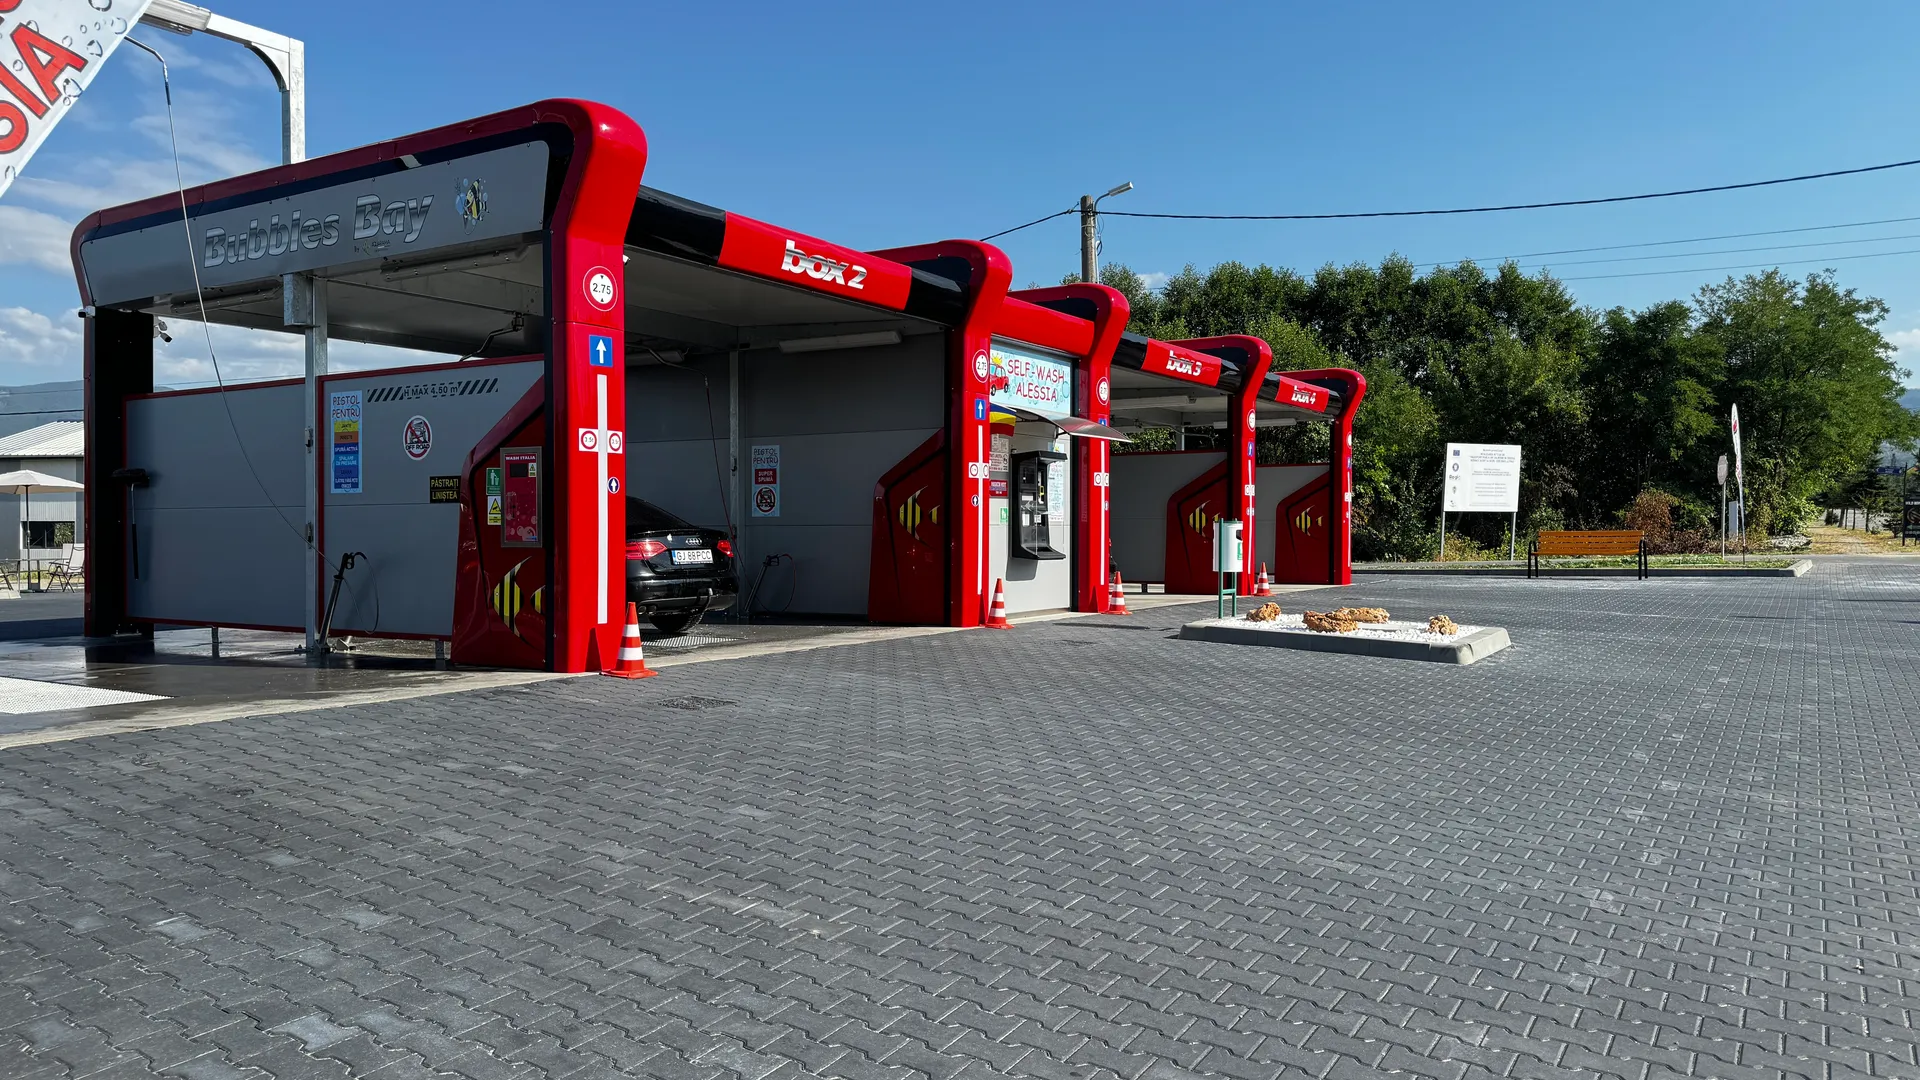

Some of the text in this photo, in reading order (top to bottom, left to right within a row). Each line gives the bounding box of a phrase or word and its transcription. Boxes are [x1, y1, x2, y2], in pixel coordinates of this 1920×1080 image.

[204, 194, 434, 268] Bubbles Bay
[781, 239, 867, 290] box 2
[592, 282, 612, 295] 2.75
[1166, 350, 1202, 376] box 3
[333, 395, 360, 405] PISTOL
[403, 389, 409, 397] H
[411, 387, 429, 396] MAX
[430, 386, 448, 395] 4.50
[1015, 382, 1058, 402] ALESSIA
[1292, 385, 1316, 404] box 4
[332, 408, 360, 418] PENTRU
